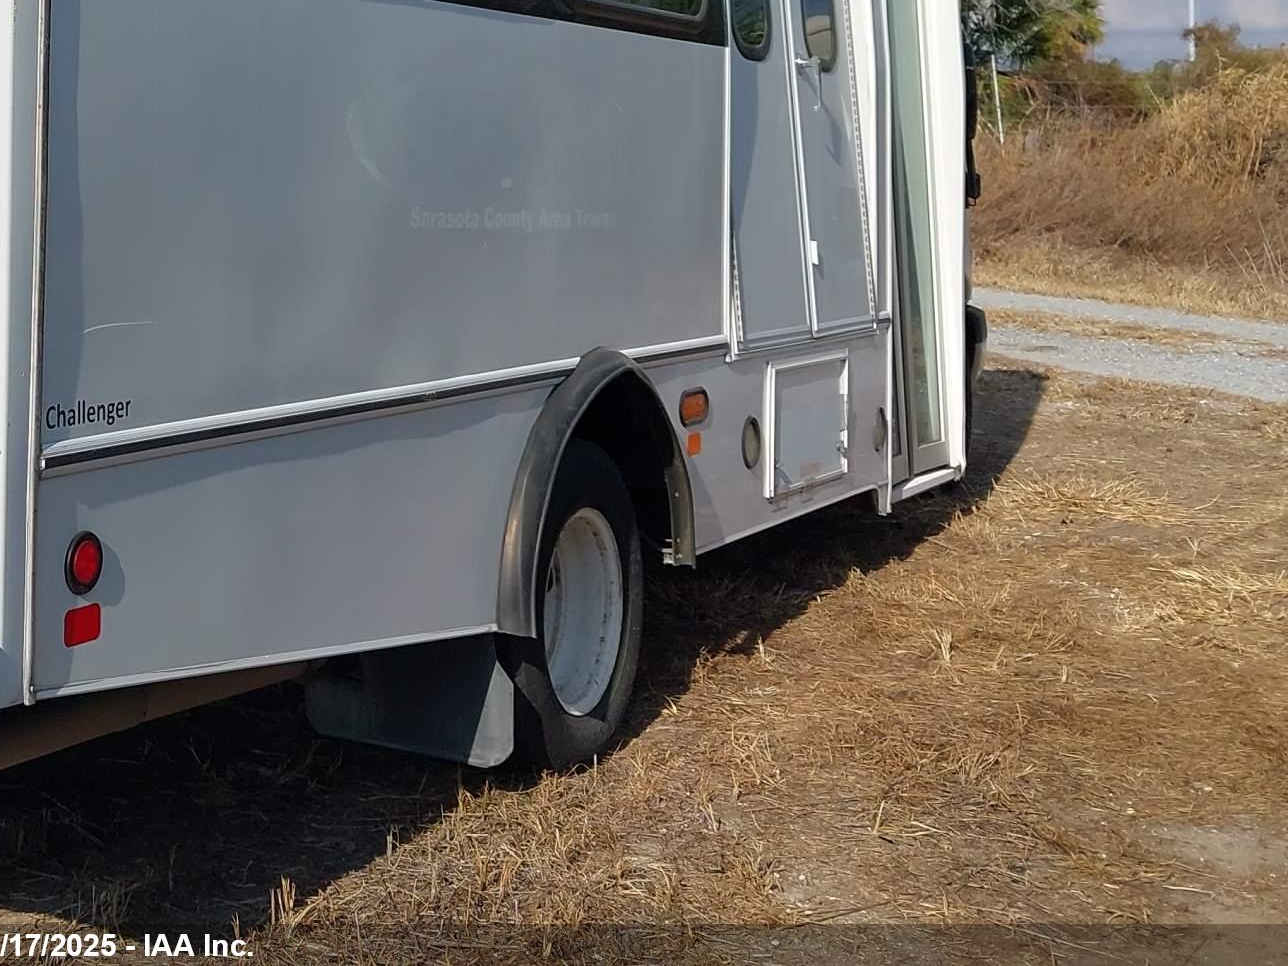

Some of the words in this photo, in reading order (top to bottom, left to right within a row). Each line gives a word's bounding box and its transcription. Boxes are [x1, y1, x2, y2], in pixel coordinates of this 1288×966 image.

[484, 206, 535, 233] County
[539, 207, 571, 230] Area
[45, 399, 132, 429] Challenger
